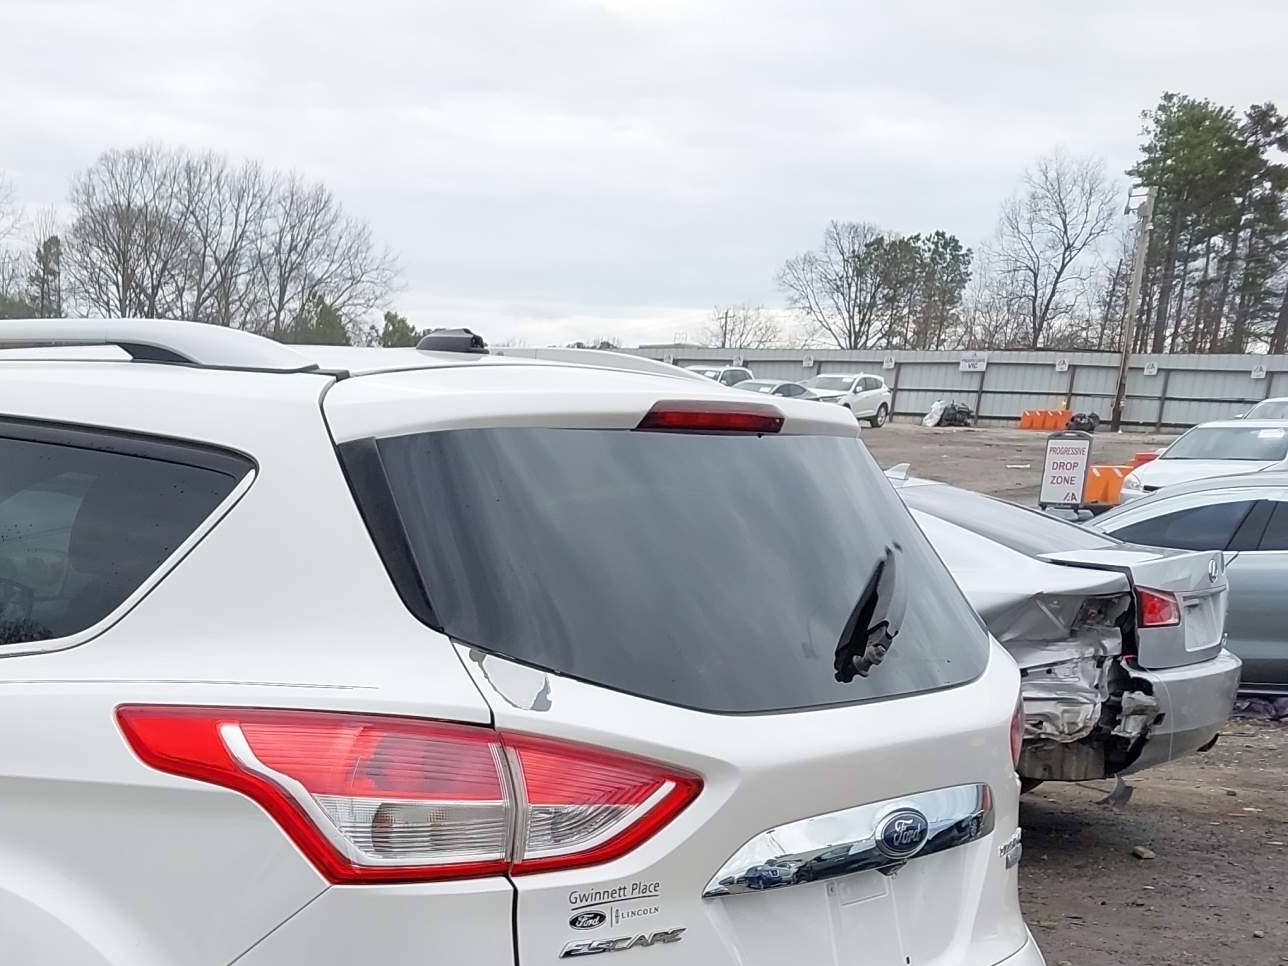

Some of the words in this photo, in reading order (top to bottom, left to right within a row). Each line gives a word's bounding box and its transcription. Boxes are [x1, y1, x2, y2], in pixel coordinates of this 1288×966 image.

[1049, 446, 1087, 455] PROGRESSIVE
[1052, 462, 1079, 471] DROP
[1050, 476, 1077, 485] ZONE
[894, 819, 921, 846] Ford
[569, 886, 627, 904] Gwinnett
[631, 881, 660, 895] Place
[621, 906, 660, 919] LINCOLN
[575, 913, 601, 927] Ford
[559, 928, 687, 959] ESCAPE
